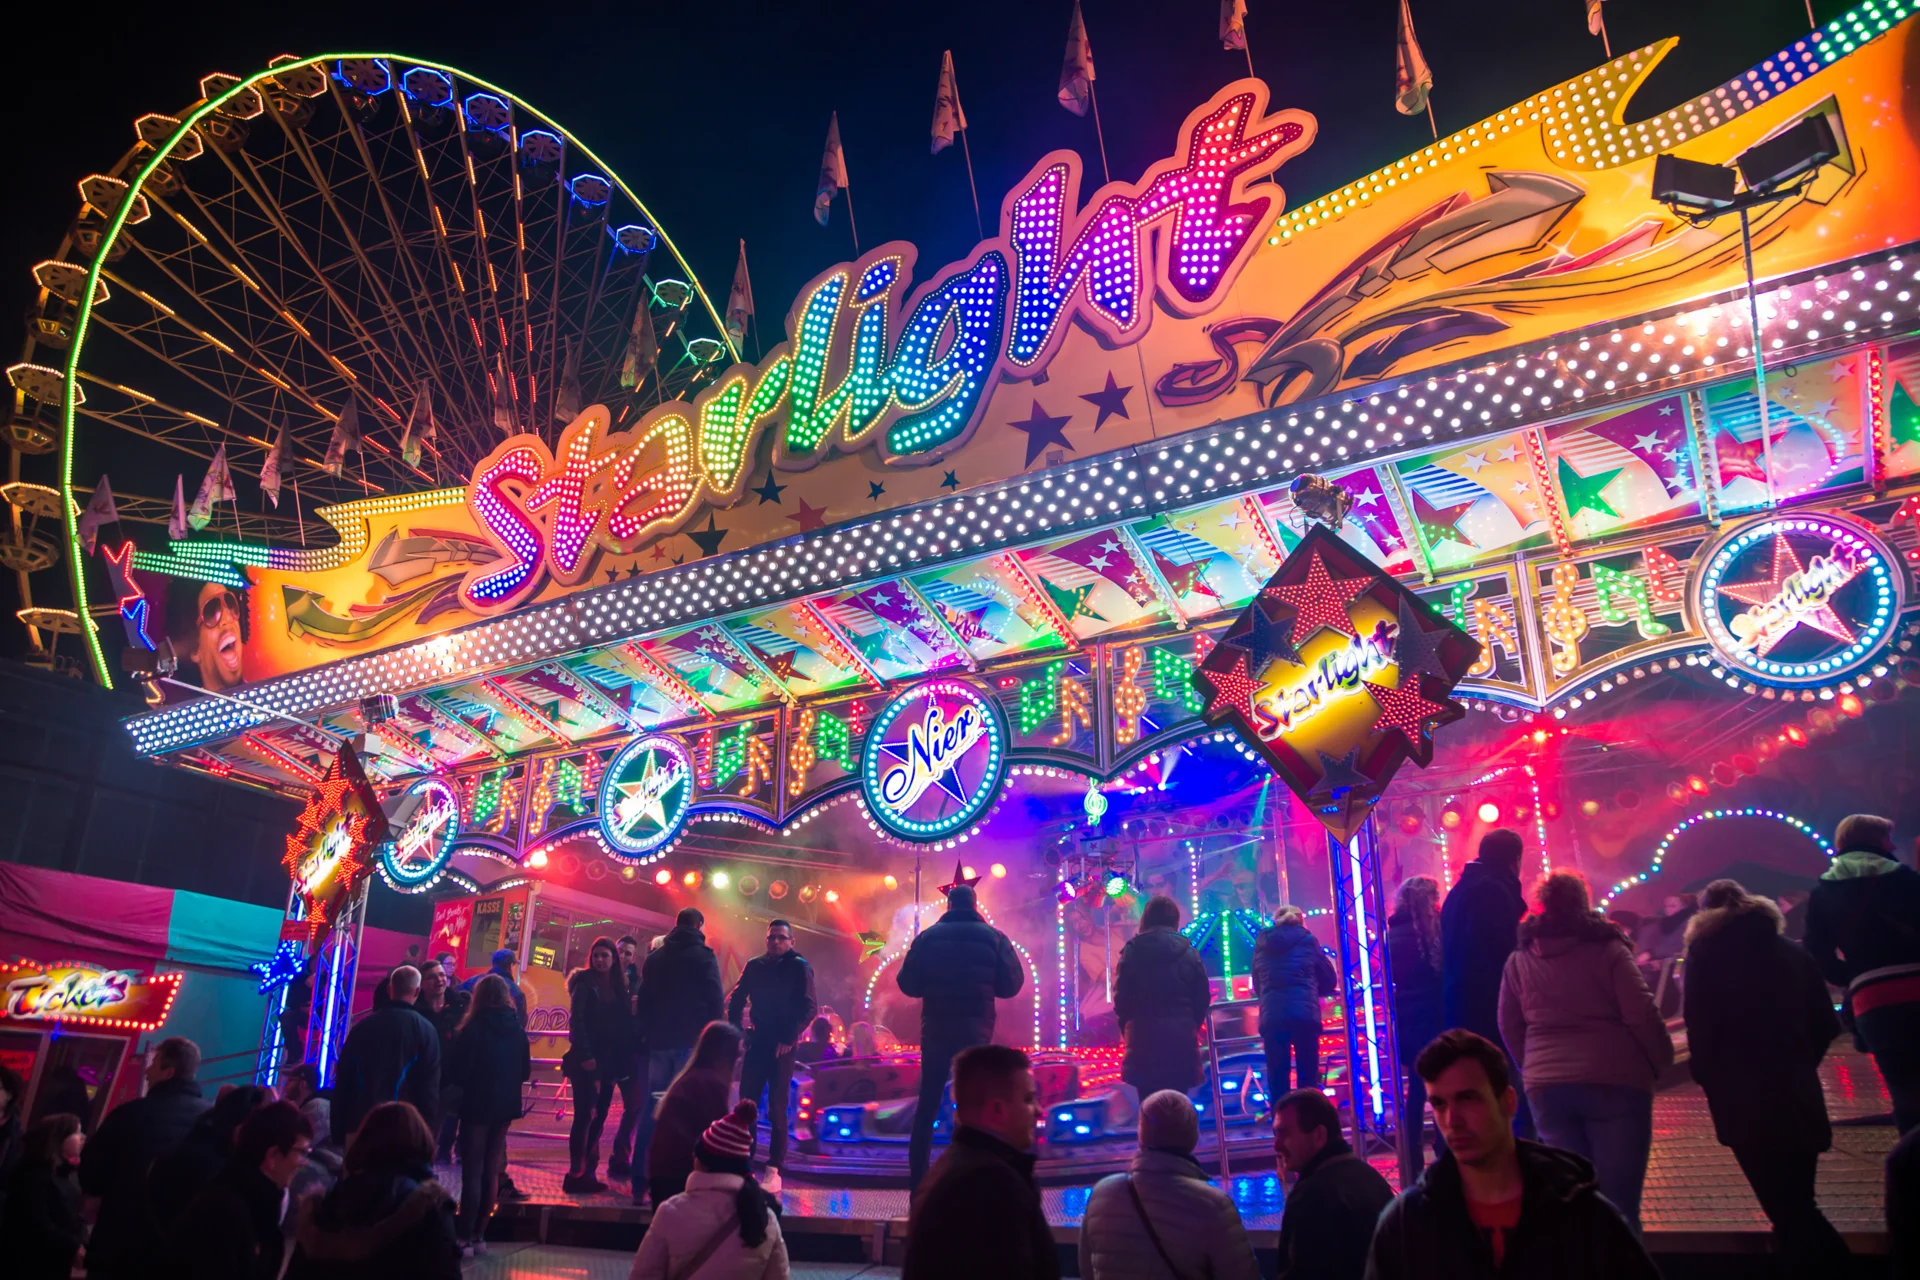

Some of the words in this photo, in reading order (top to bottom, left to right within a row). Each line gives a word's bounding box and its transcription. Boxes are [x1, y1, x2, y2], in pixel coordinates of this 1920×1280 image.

[463, 88, 1308, 606] Starlight
[1252, 618, 1398, 738] Starlight
[881, 707, 977, 806] Nier
[476, 901, 501, 914] KASSE
